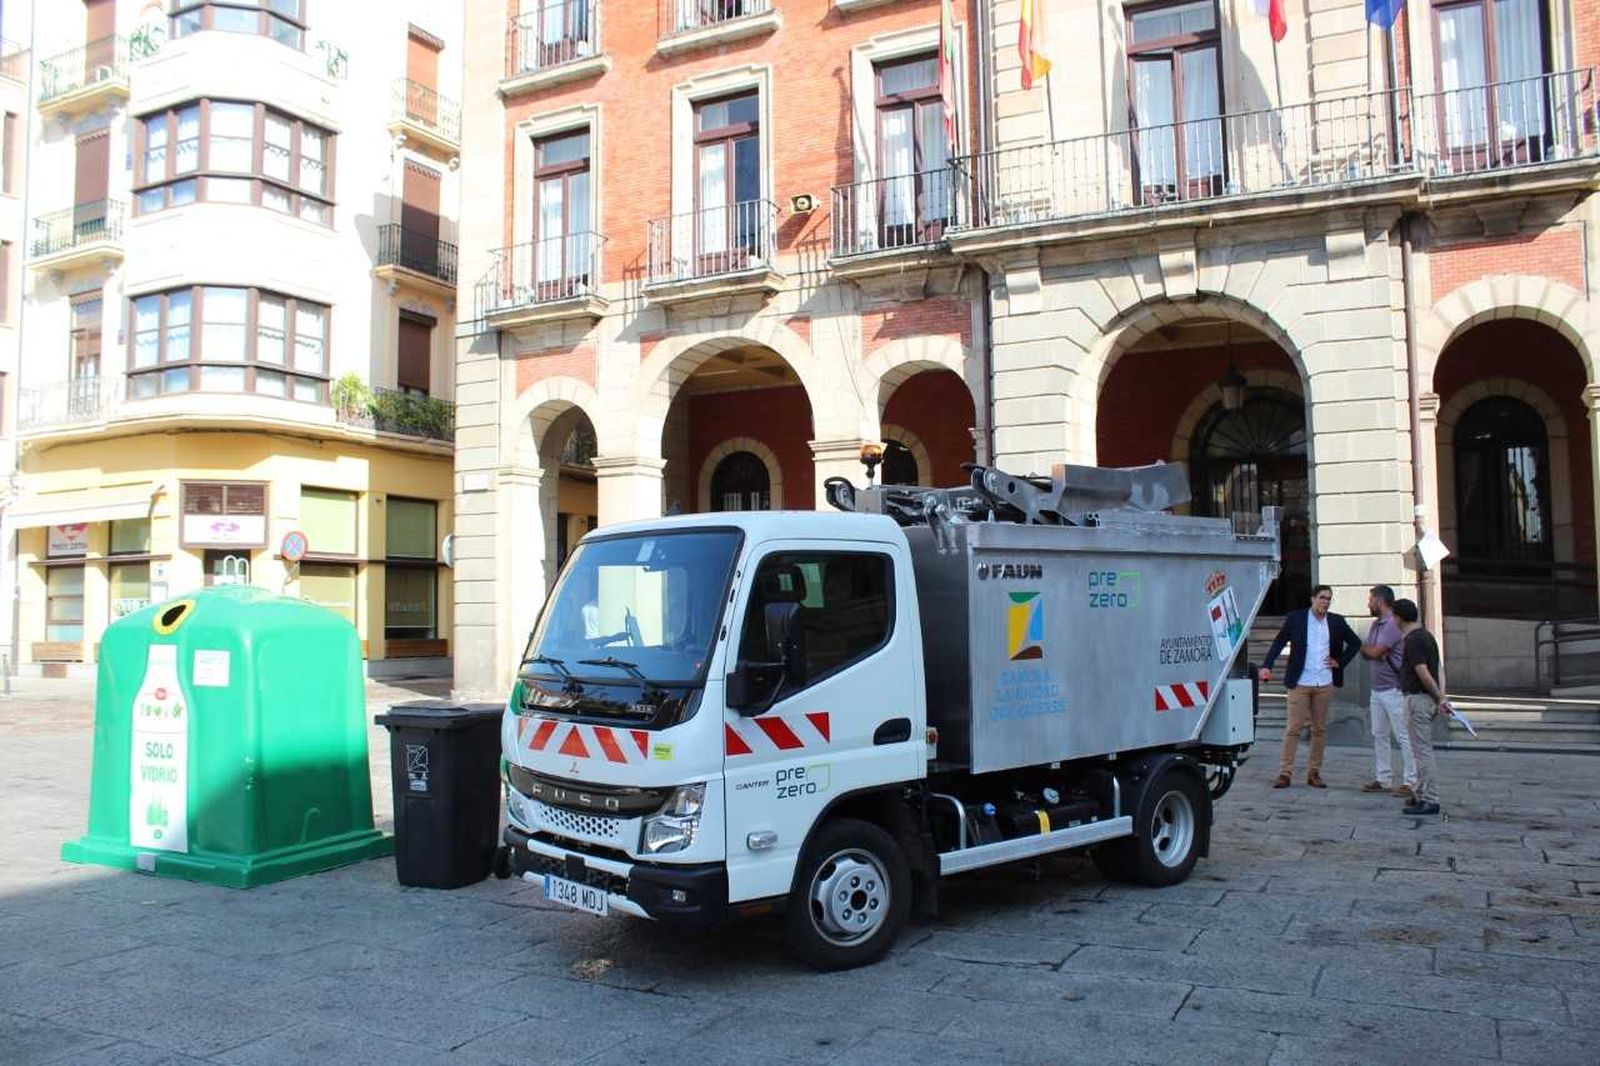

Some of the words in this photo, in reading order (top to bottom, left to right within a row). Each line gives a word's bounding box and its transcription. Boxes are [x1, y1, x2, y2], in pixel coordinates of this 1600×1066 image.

[992, 565, 1043, 580] FAUN
[1088, 571, 1118, 589] pre
[1089, 592, 1128, 608] zero
[1160, 649, 1172, 664] DE
[1173, 647, 1213, 663] ZAMORA
[145, 742, 174, 759] SOLO
[141, 764, 177, 784] VIDRIO
[775, 766, 805, 786] pre
[532, 783, 619, 811] FUSO
[776, 781, 817, 799] zero
[552, 879, 578, 905] 1348
[581, 888, 604, 912] MDJ
